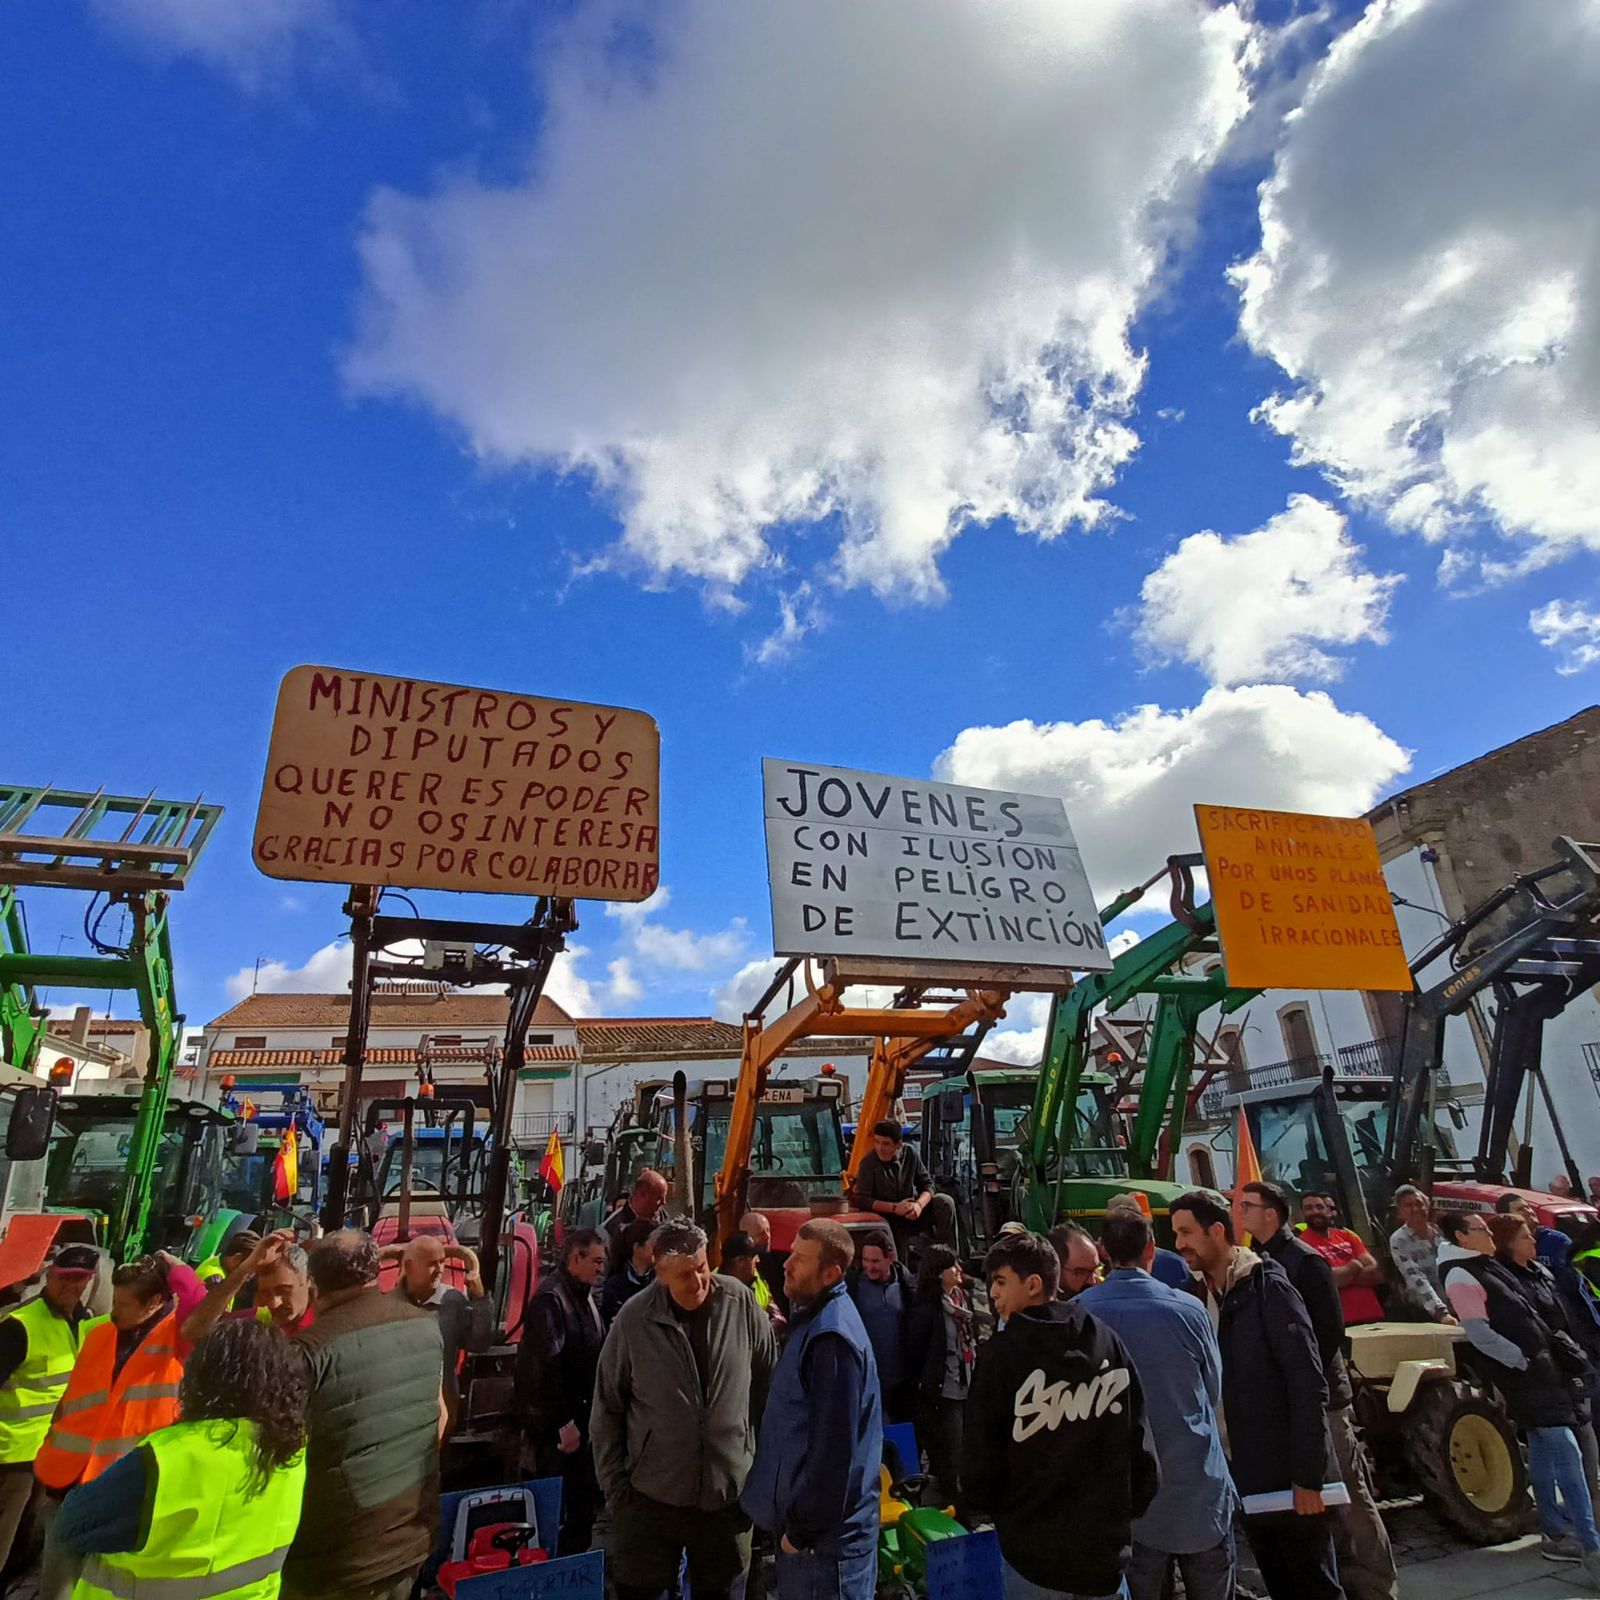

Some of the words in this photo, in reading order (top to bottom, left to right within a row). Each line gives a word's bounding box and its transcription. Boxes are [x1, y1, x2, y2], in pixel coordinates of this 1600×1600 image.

[309, 672, 573, 738] MINISTROS
[594, 713, 617, 745] Y
[350, 725, 633, 780] DIPUTADOS
[274, 764, 442, 806] QUERER
[462, 778, 507, 807] ES
[521, 781, 650, 816] PODER
[776, 768, 1024, 838] JOVENES
[323, 801, 393, 831] NO
[1208, 810, 1368, 840] SACRIFICANDO
[794, 825, 868, 858] CON
[1255, 833, 1364, 861] ANIMALES
[258, 835, 406, 868] GRACIAS
[416, 844, 476, 877] POR
[488, 850, 659, 895] COLABORAR
[790, 861, 847, 892] EN
[1218, 856, 1256, 881] POR
[1270, 865, 1317, 883] UNOS
[1239, 890, 1273, 913] DE
[1295, 892, 1392, 915] SANIDAD
[802, 903, 854, 936] DE
[759, 1090, 792, 1101] LENA
